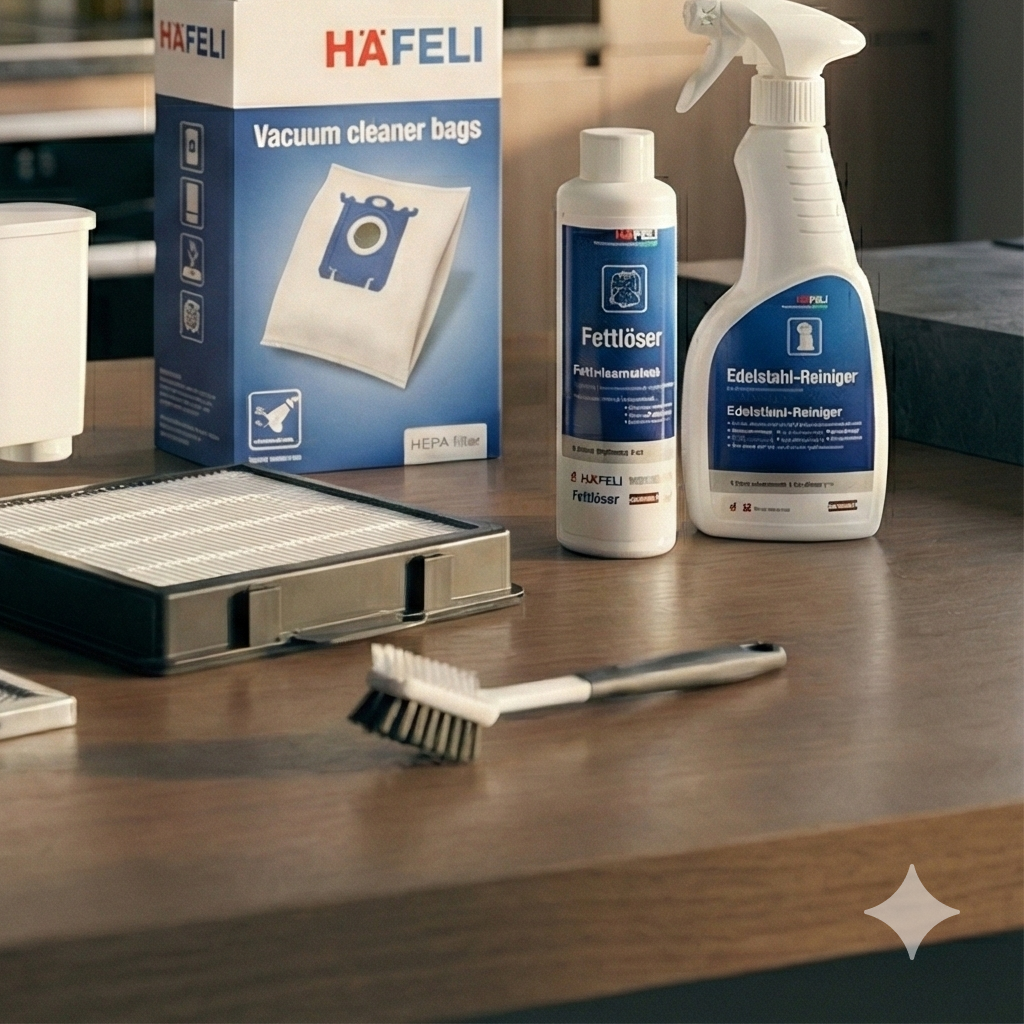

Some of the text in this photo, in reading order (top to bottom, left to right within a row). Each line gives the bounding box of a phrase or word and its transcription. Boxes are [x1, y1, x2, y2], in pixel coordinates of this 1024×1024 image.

[160, 20, 226, 59] HÄFELI
[325, 26, 483, 68] HÄFELI
[253, 117, 482, 148] Vacuum cleaner bags
[581, 326, 663, 349] Fettlöser
[727, 367, 859, 387] Edelstahl-Reiniger
[410, 436, 449, 451] HEPA
